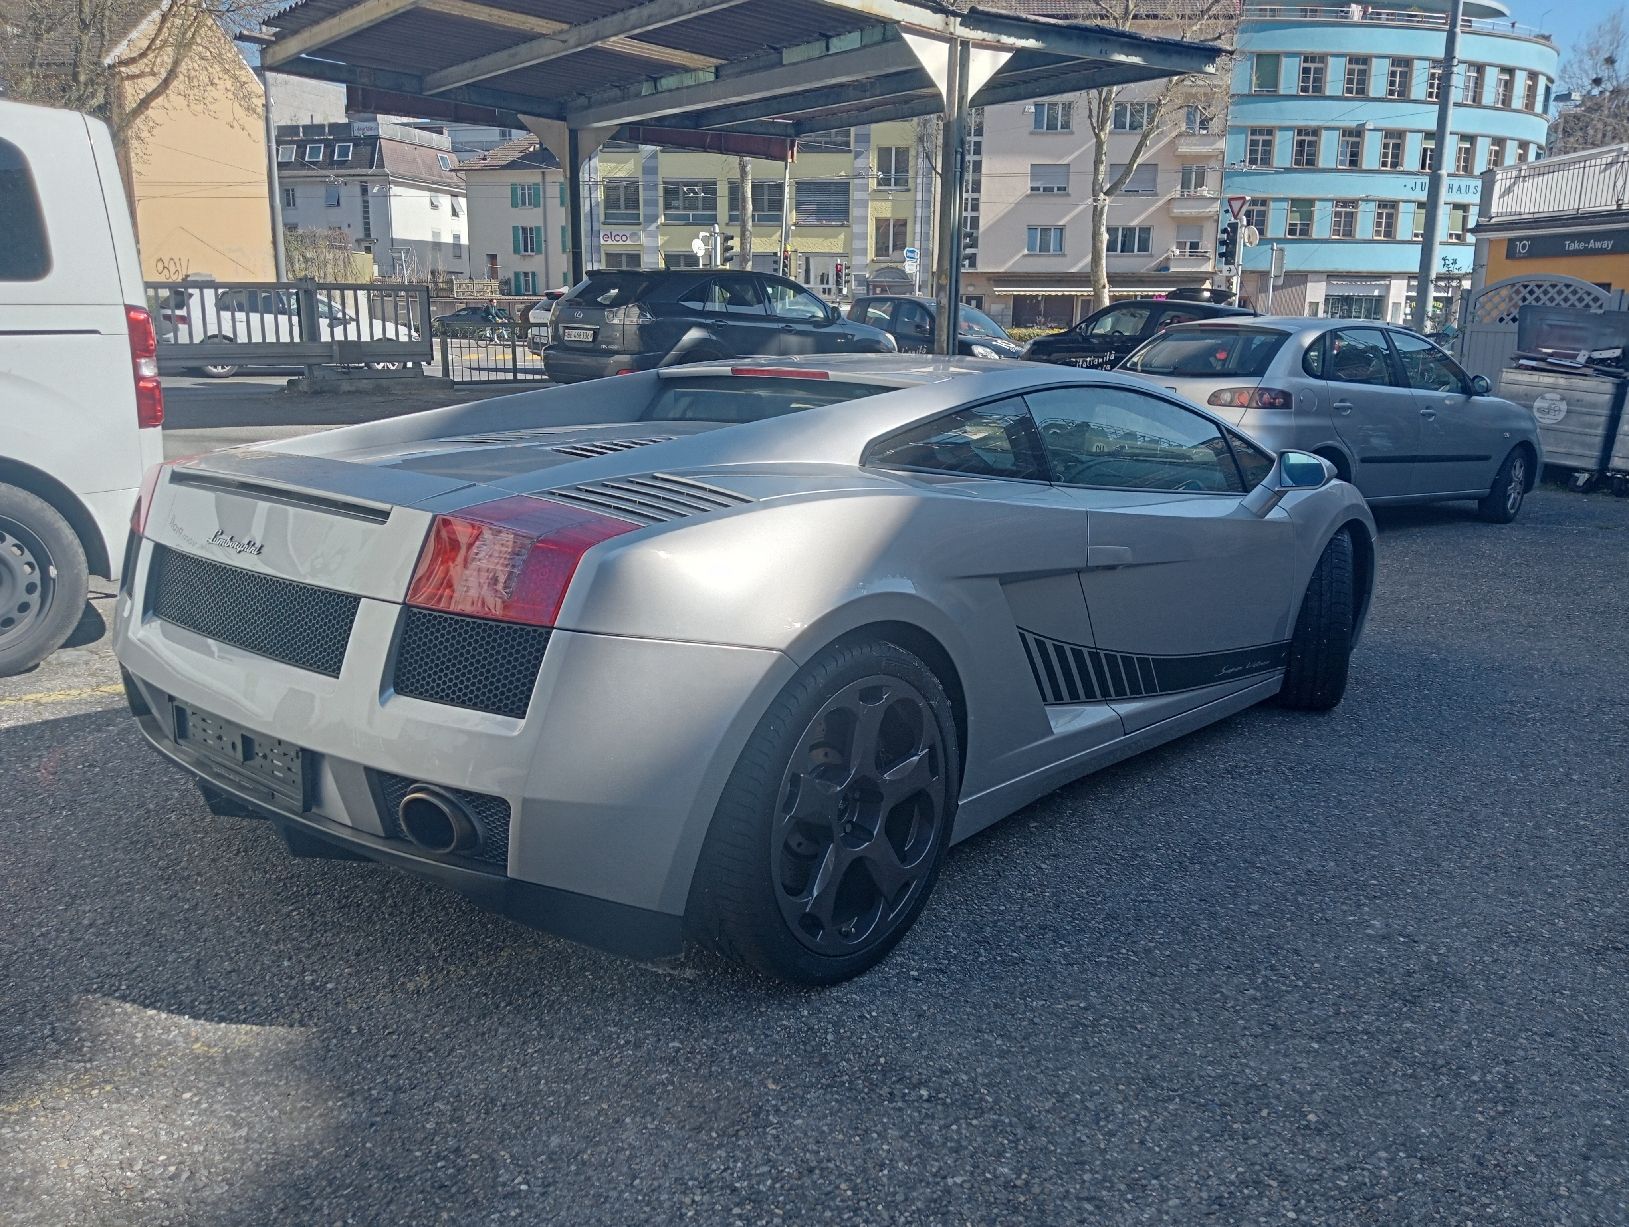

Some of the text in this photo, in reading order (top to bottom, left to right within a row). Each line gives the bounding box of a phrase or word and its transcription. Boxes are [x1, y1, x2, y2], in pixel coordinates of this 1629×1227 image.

[602, 231, 629, 243] elco
[1564, 239, 1614, 251] Take-Away
[206, 529, 264, 556] Lamborghini
